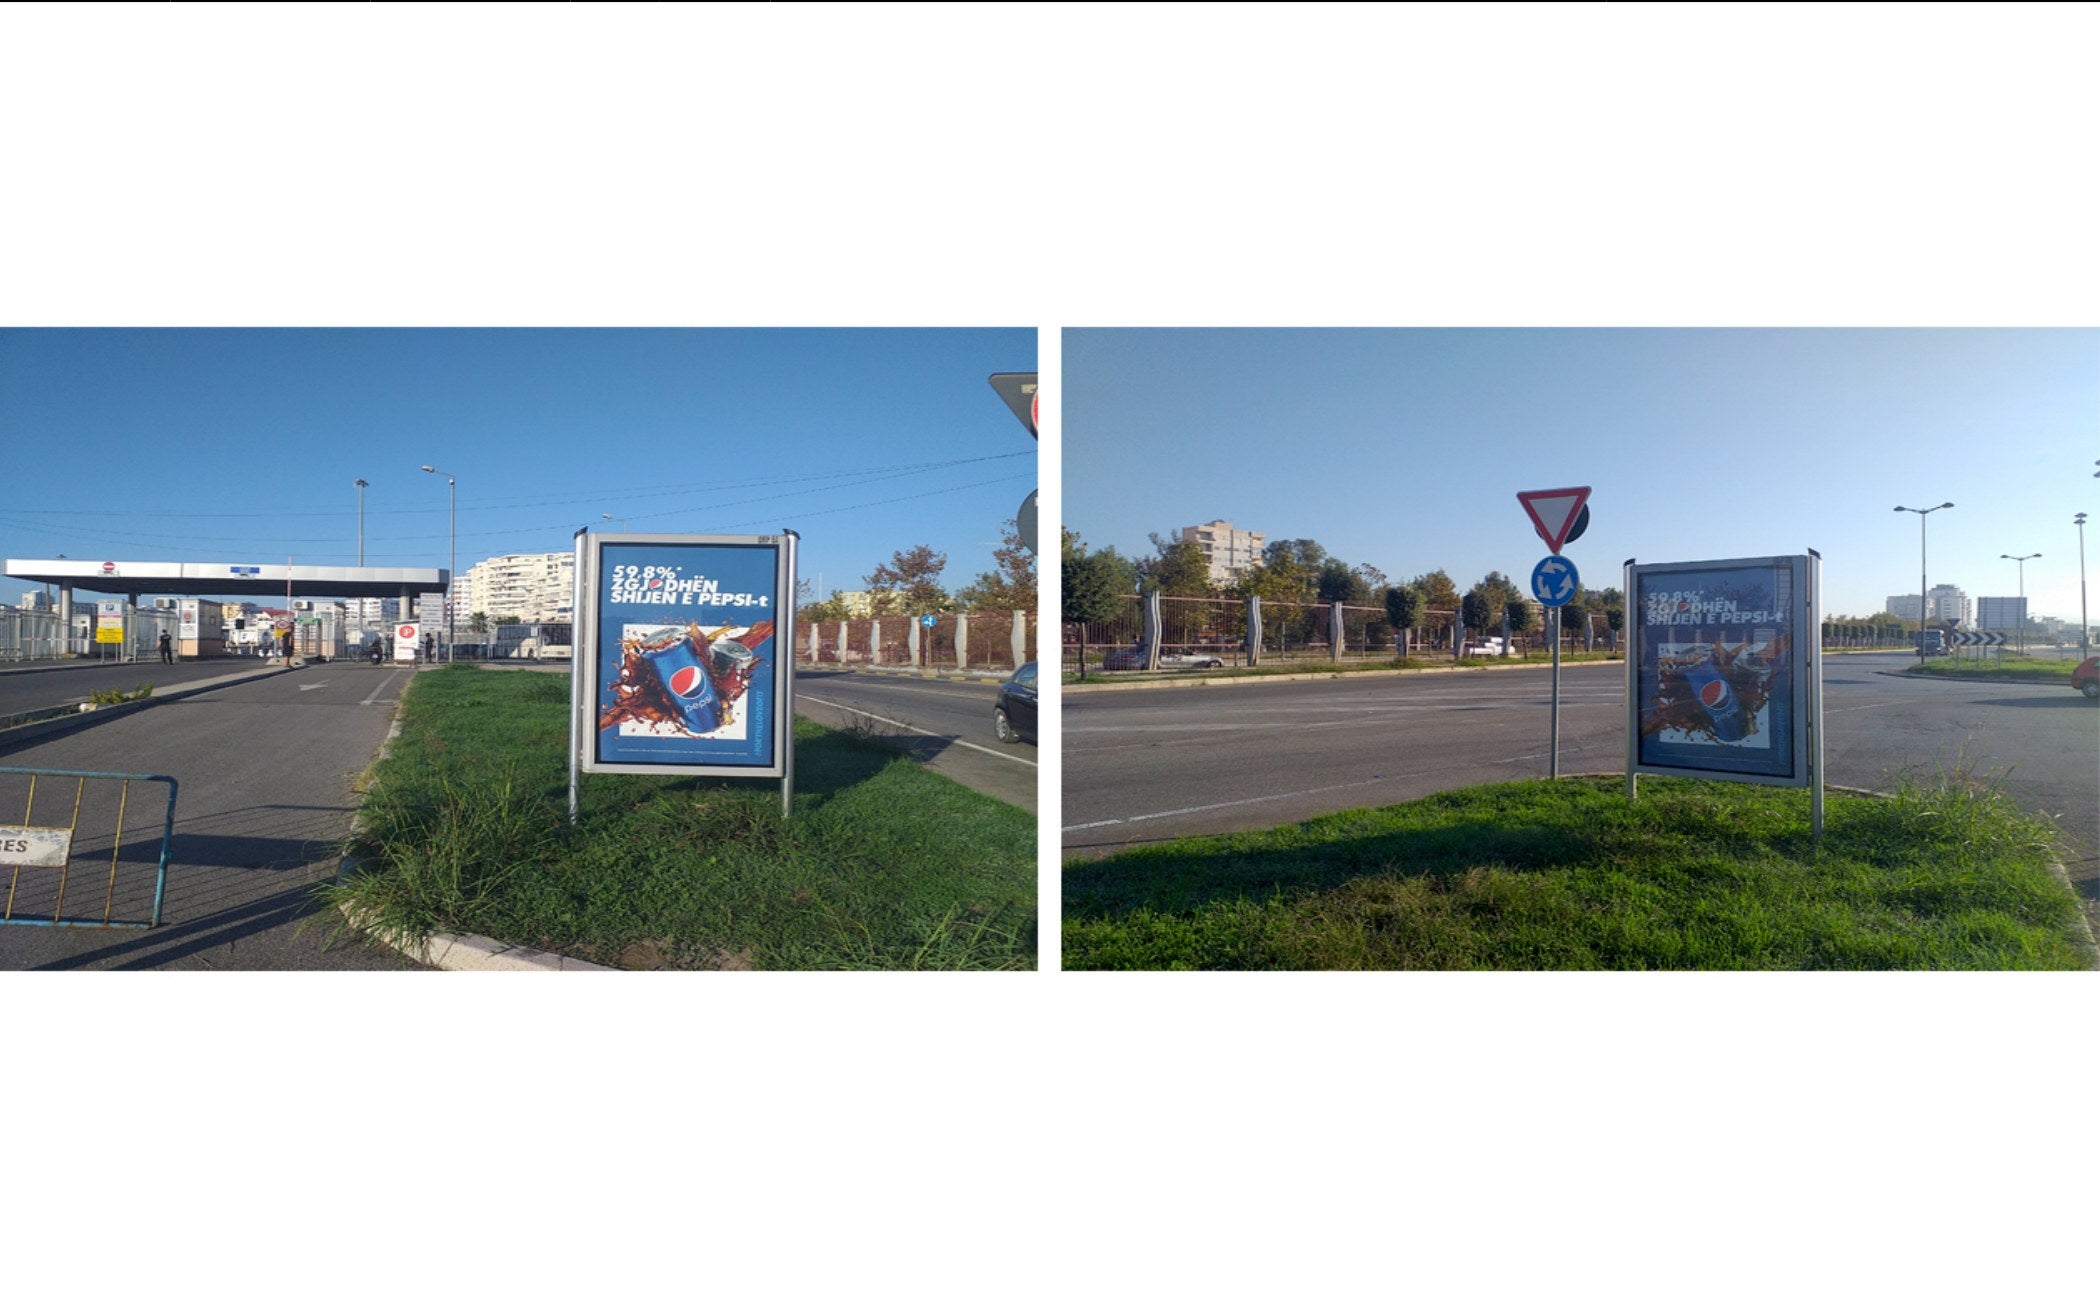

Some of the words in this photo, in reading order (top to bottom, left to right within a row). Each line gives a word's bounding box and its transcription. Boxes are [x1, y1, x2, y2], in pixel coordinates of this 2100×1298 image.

[610, 590, 677, 605] SHIJEN
[682, 593, 694, 605] E
[698, 592, 769, 607] PEPSI-t
[1646, 611, 1702, 626] SHIJEN
[1706, 613, 1716, 625] E
[1721, 610, 1784, 624] PEPSI-t
[0, 838, 28, 853] ES
